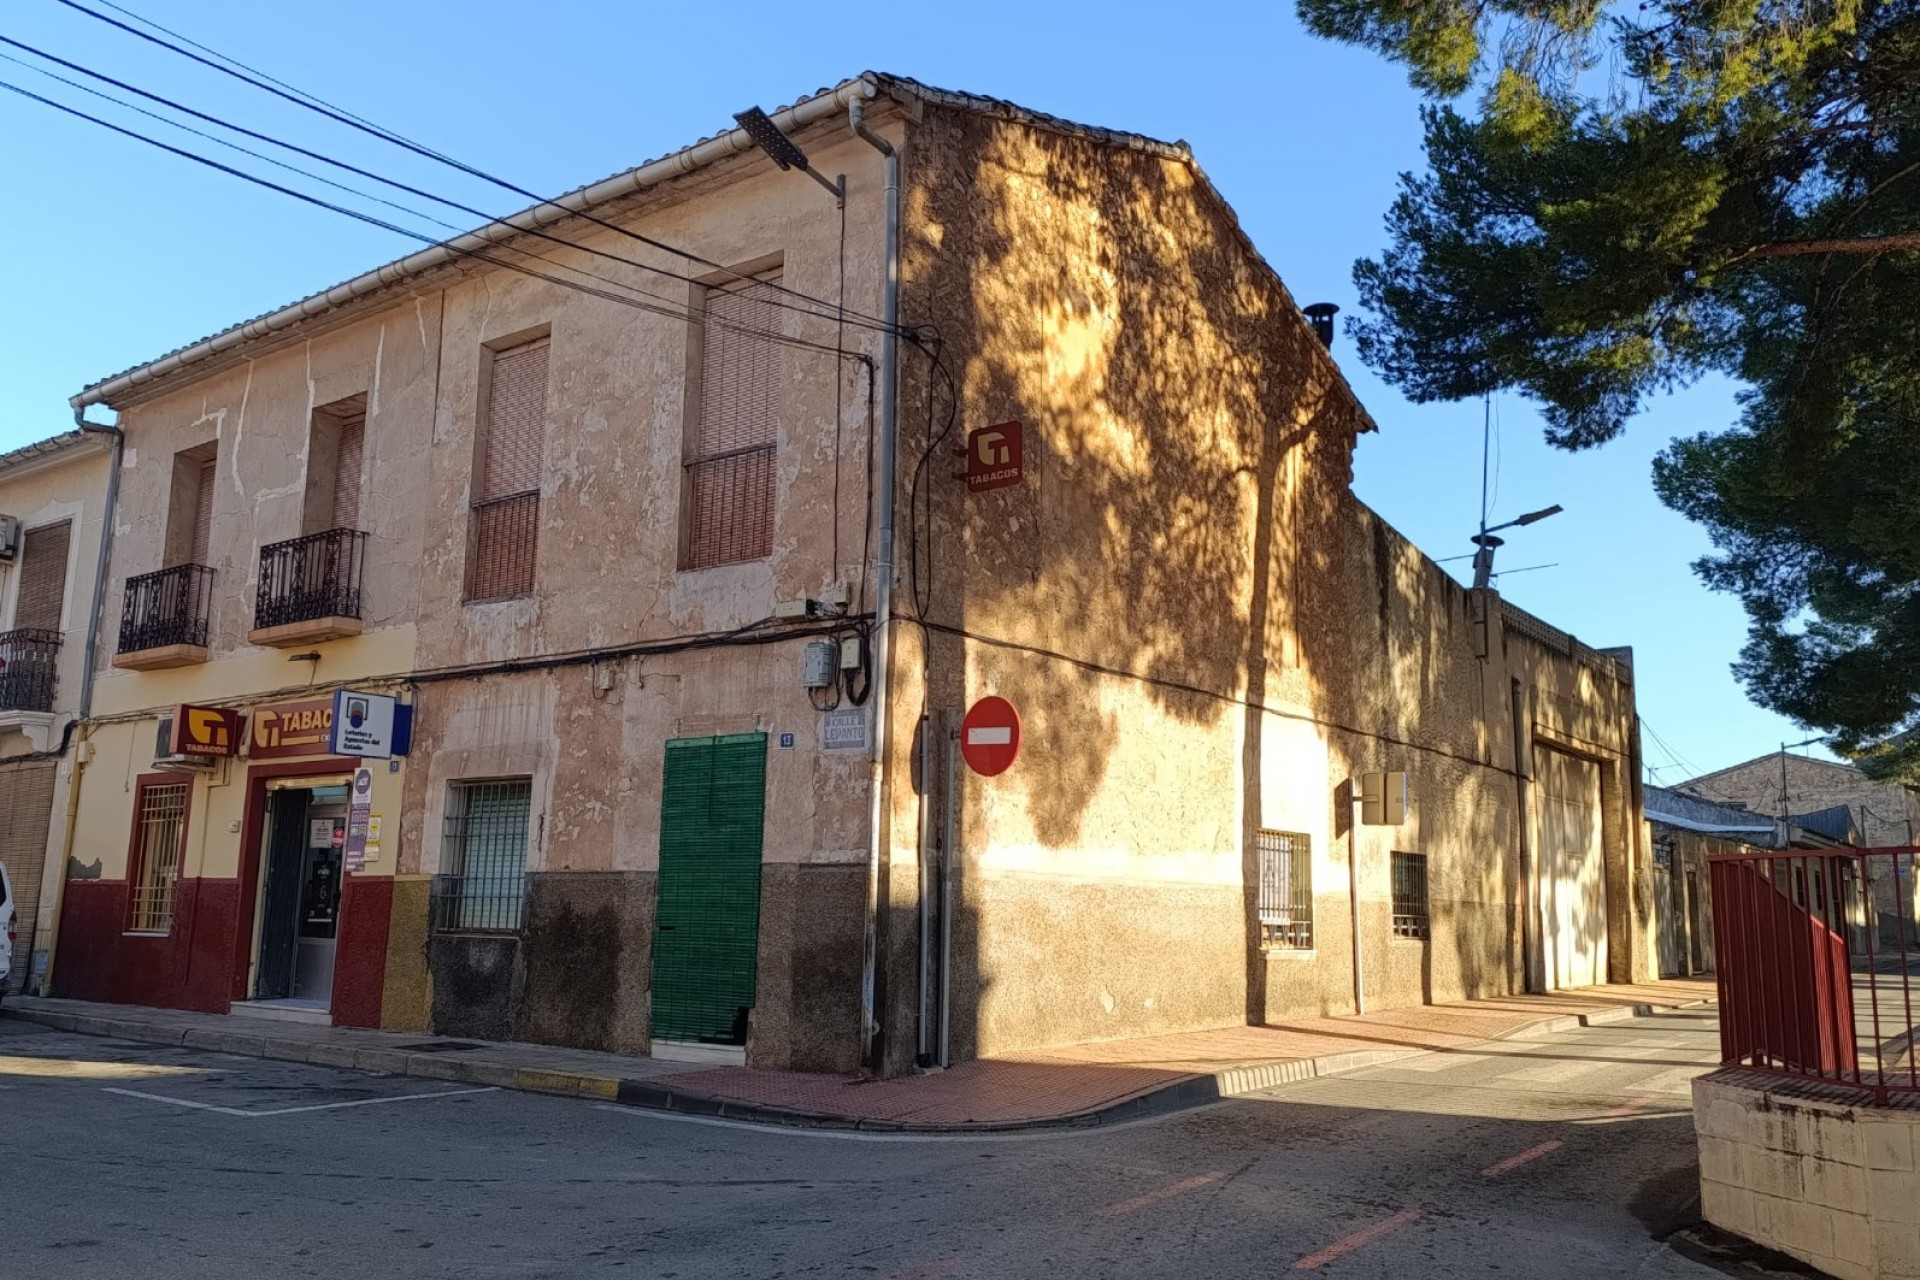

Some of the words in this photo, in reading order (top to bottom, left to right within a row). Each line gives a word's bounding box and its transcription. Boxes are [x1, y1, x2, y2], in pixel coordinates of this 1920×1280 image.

[970, 467, 1019, 485] TABACOS
[281, 708, 333, 732] TABAC
[831, 715, 859, 726] CALLE
[824, 726, 863, 740] LEPANTO
[783, 735, 792, 746] 13
[185, 743, 228, 755] TABACOS
[343, 743, 364, 751] Estado
